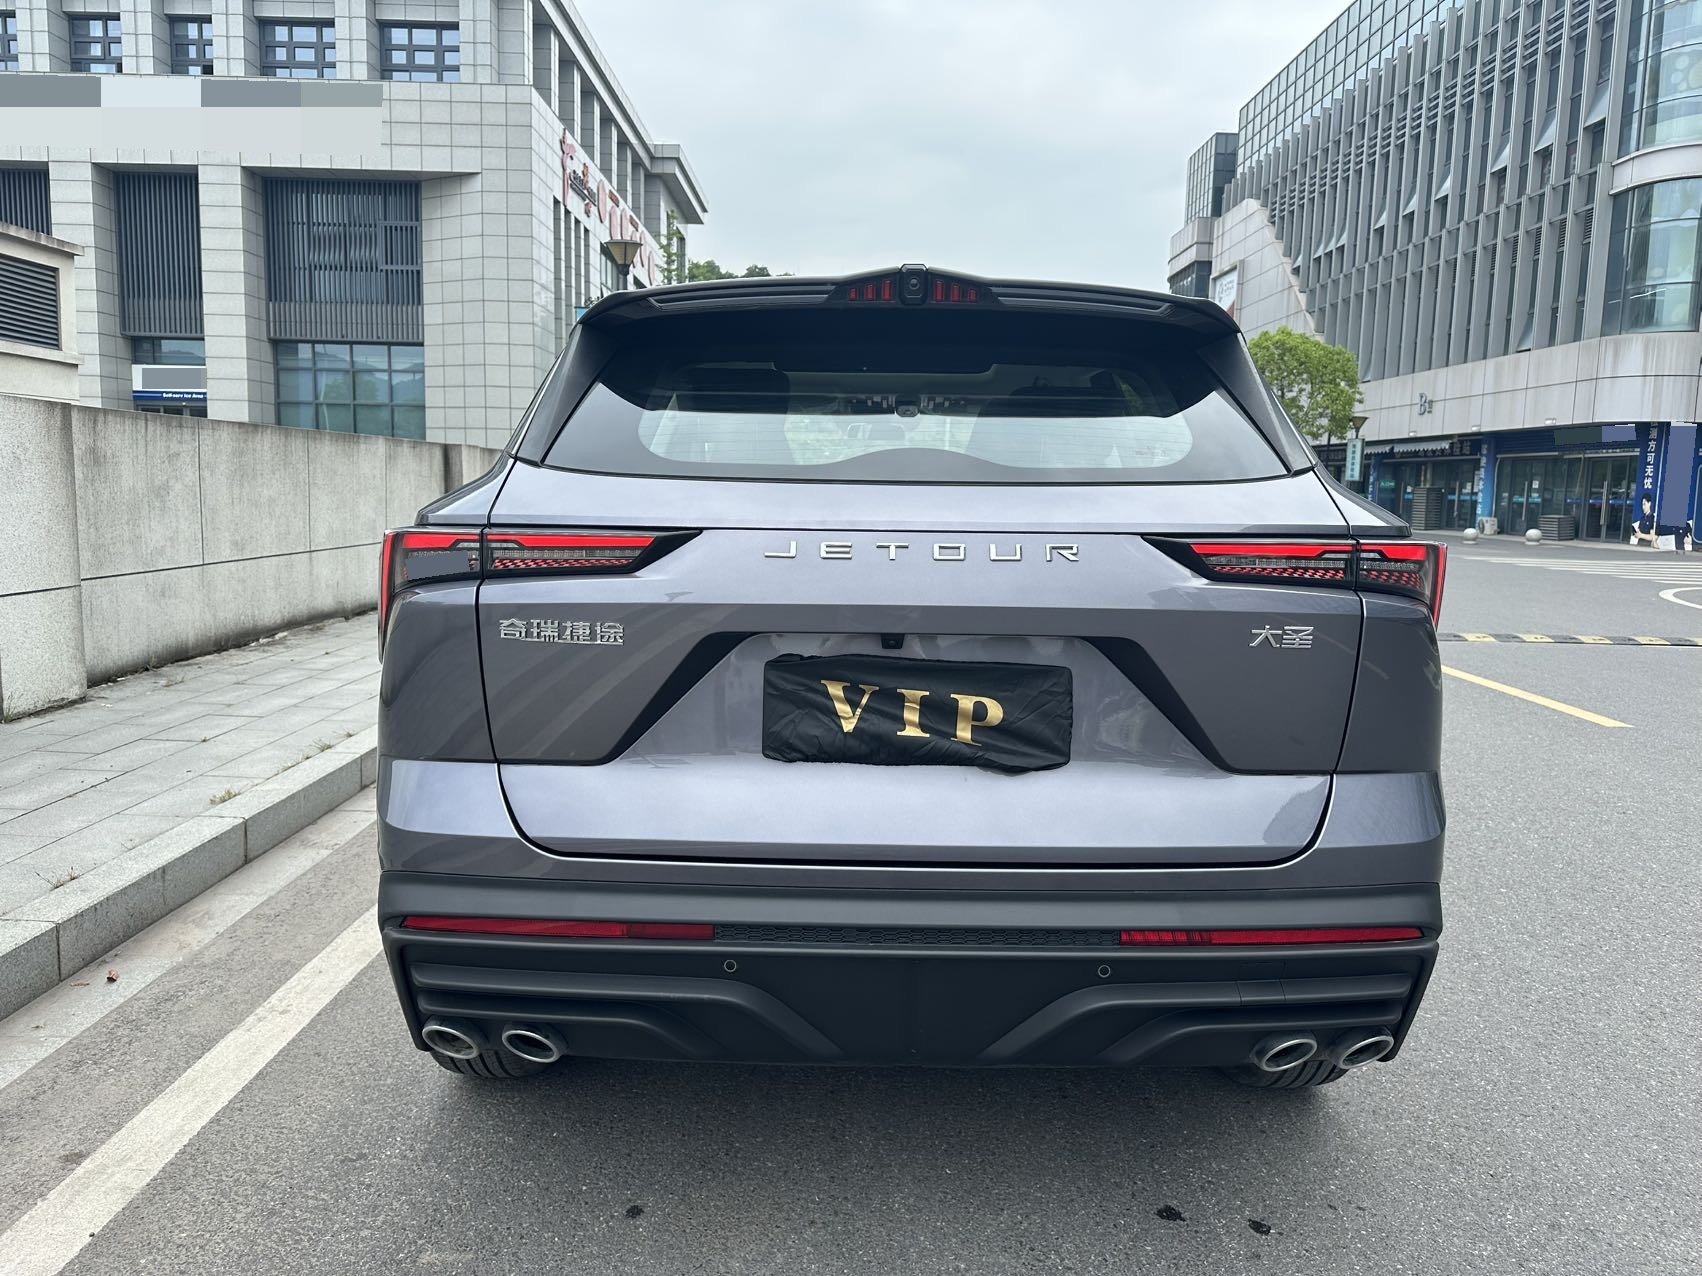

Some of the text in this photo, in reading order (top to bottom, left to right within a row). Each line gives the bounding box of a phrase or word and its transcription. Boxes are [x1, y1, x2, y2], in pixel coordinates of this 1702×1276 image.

[764, 540, 1080, 563] JETOUR
[499, 618, 624, 645] 奇瑞捷途
[1249, 625, 1314, 648] 大圣
[821, 679, 1004, 747] VIP
